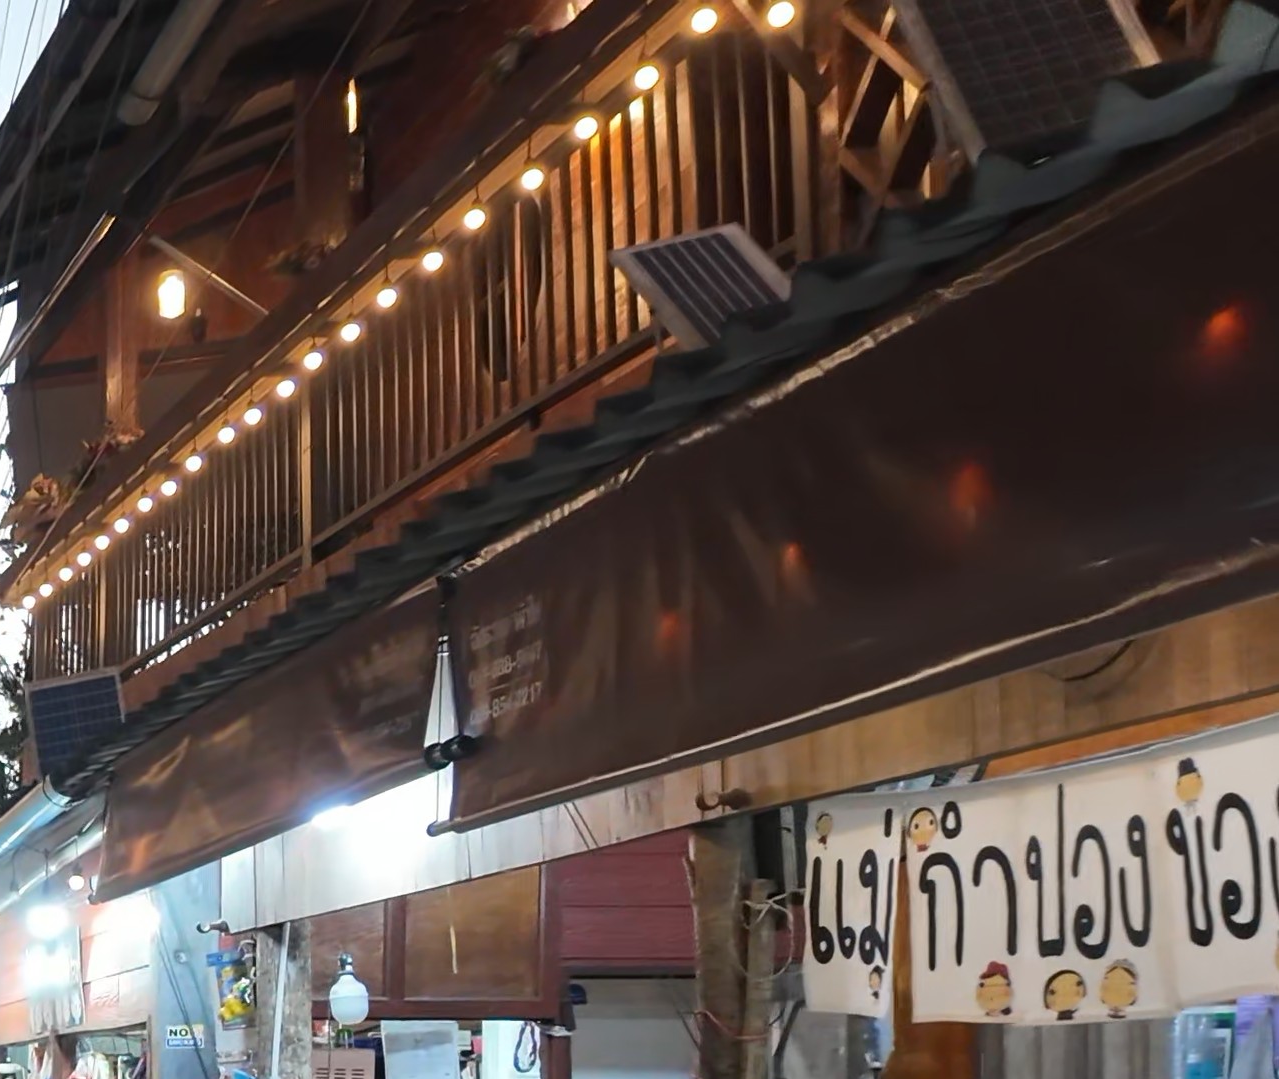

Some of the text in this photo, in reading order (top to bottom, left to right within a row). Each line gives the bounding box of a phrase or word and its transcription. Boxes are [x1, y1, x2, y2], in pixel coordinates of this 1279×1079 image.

[802, 783, 1279, 967] แม่กำปองขอ
[168, 1028, 188, 1038] NO
